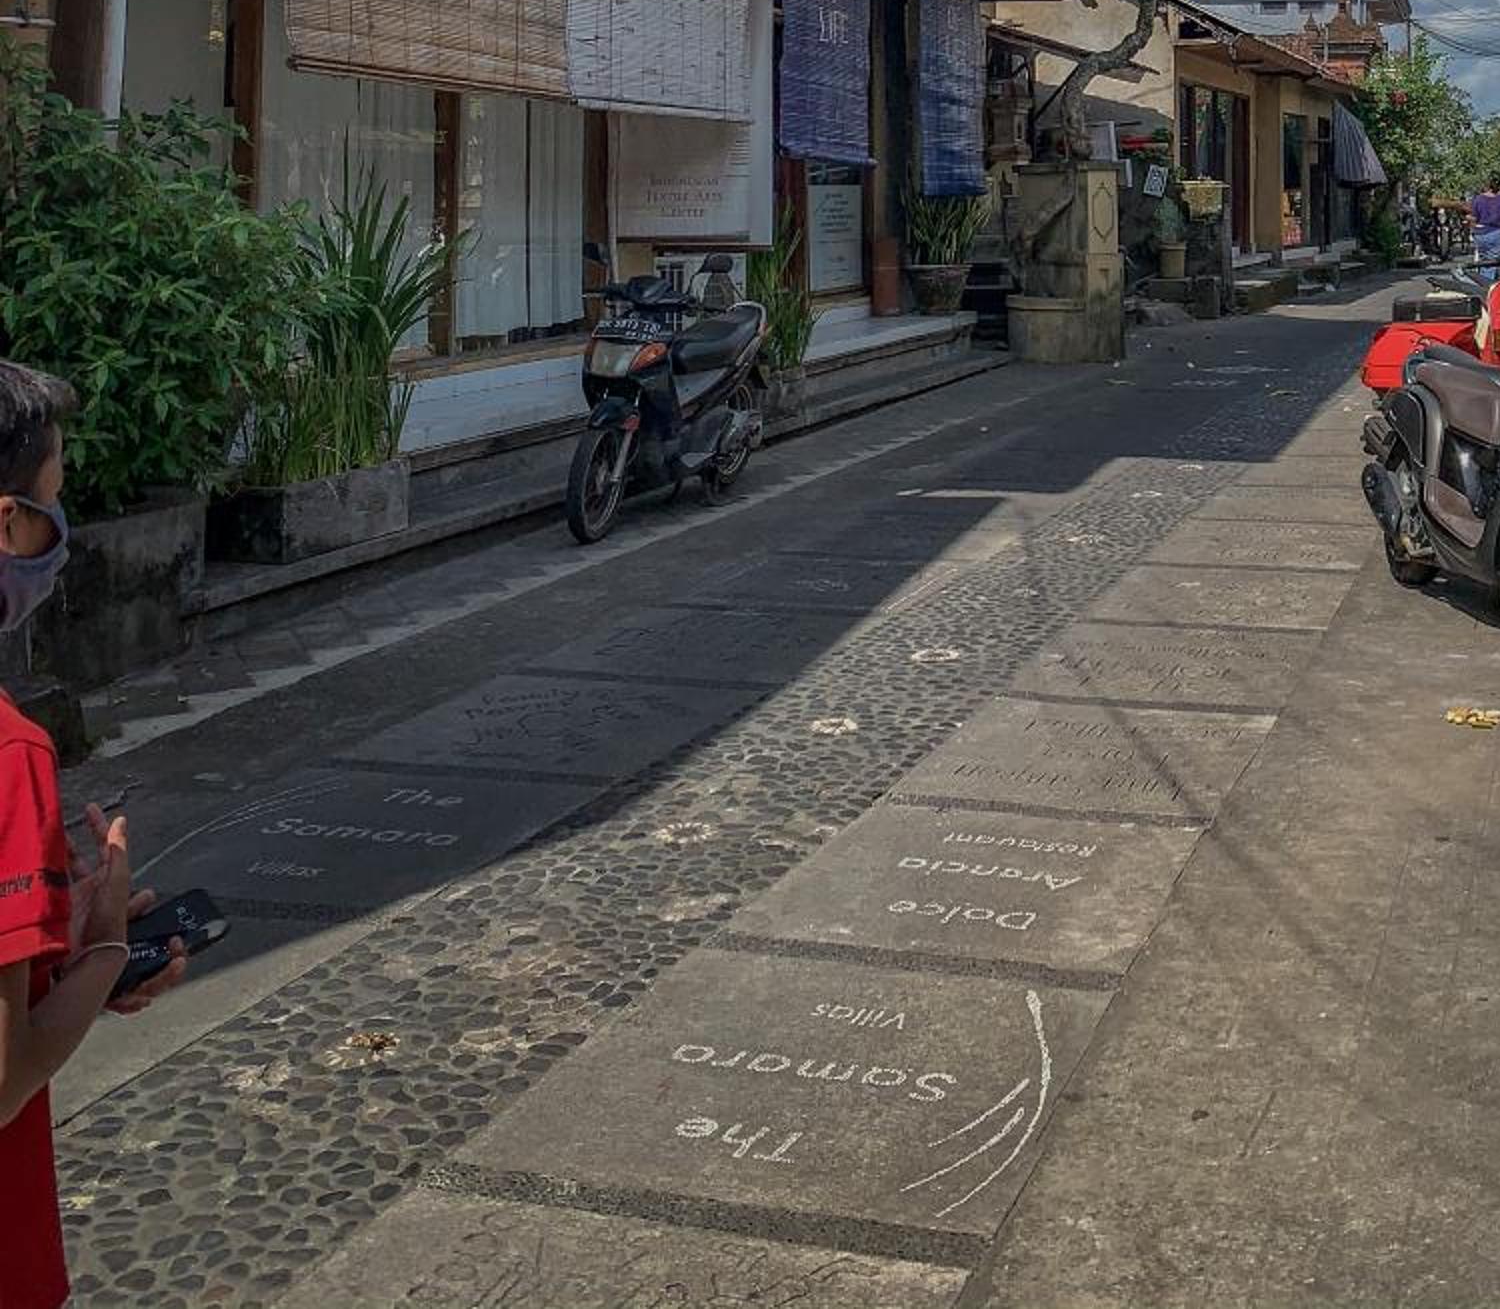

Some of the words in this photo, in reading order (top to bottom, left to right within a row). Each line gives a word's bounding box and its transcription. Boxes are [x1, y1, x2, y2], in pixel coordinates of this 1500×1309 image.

[819, 6, 850, 45] LIFE
[383, 788, 465, 807] The
[260, 818, 460, 847] Samara
[887, 898, 1037, 931] Dolce
[810, 1001, 906, 1030] Villas
[672, 1043, 958, 1102] Samara
[675, 1116, 803, 1163] The
